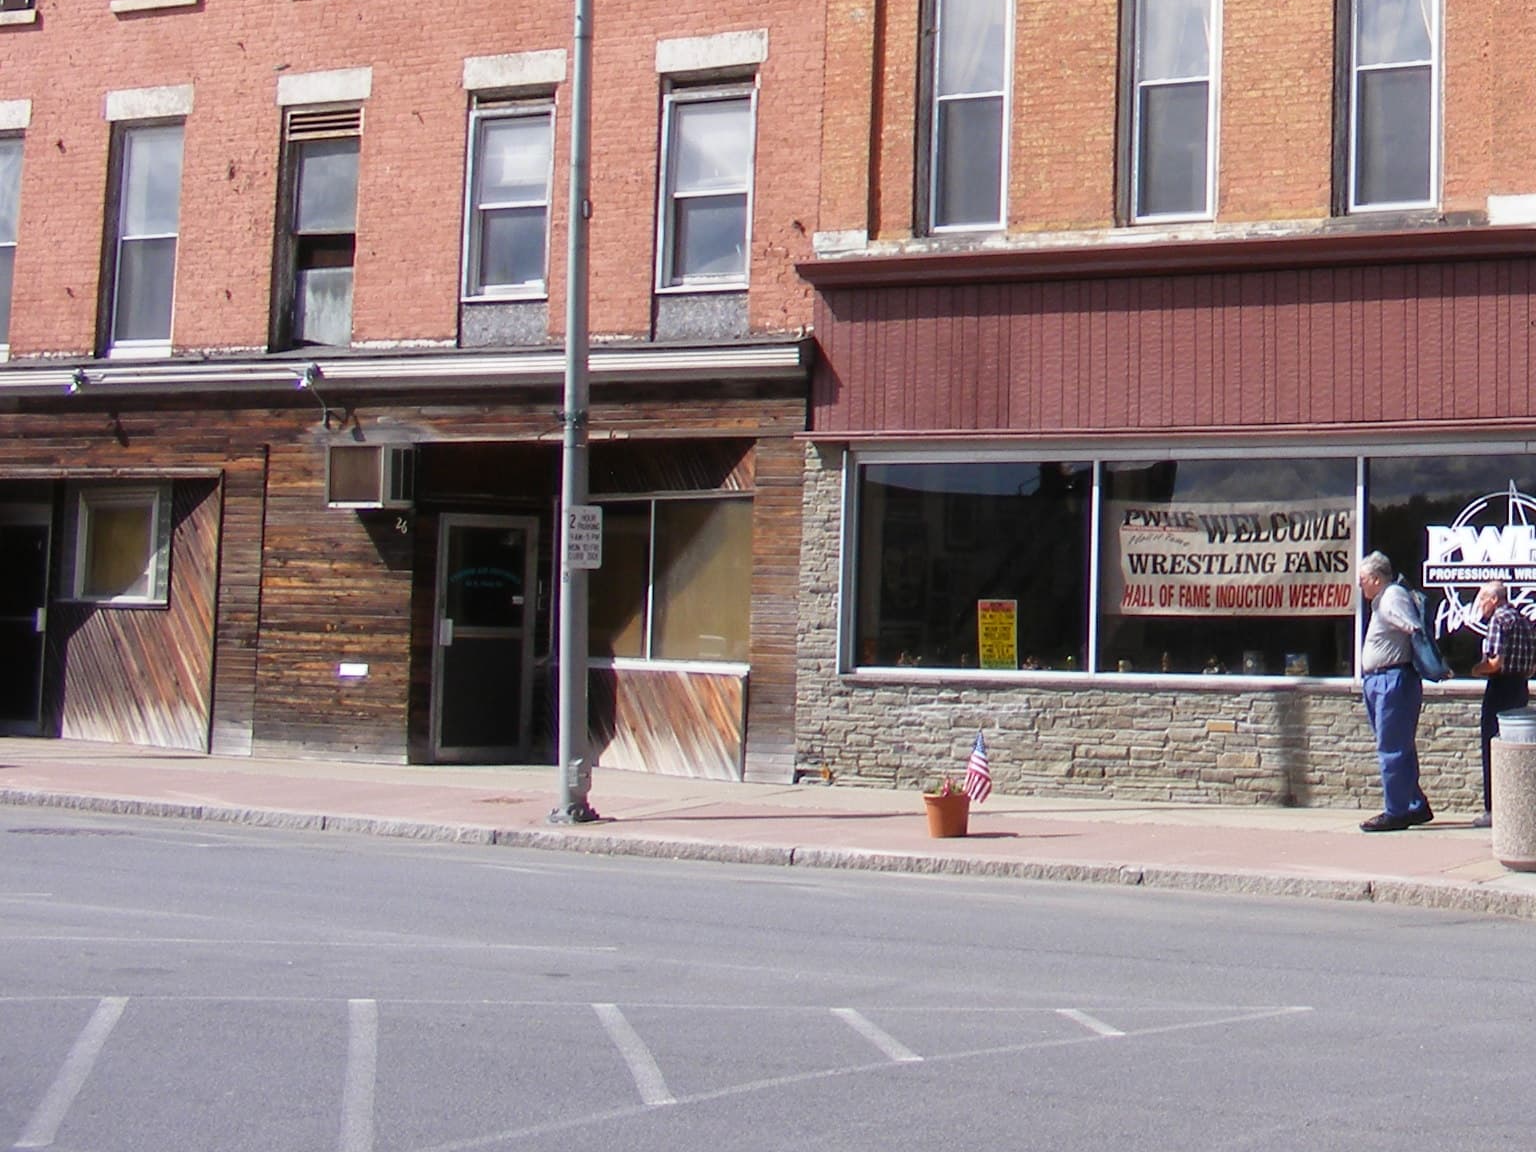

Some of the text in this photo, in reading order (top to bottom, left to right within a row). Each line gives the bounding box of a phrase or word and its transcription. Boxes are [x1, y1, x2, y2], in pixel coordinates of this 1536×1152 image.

[396, 517, 408, 534] 26
[570, 513, 577, 529] 2
[1199, 508, 1350, 544] WELCOME
[1128, 550, 1349, 575] WRESTLING FANS
[1429, 567, 1512, 581] PROFESSIONAL
[1122, 584, 1351, 608] HALL OF FAME INDUCTION WEEKEND
